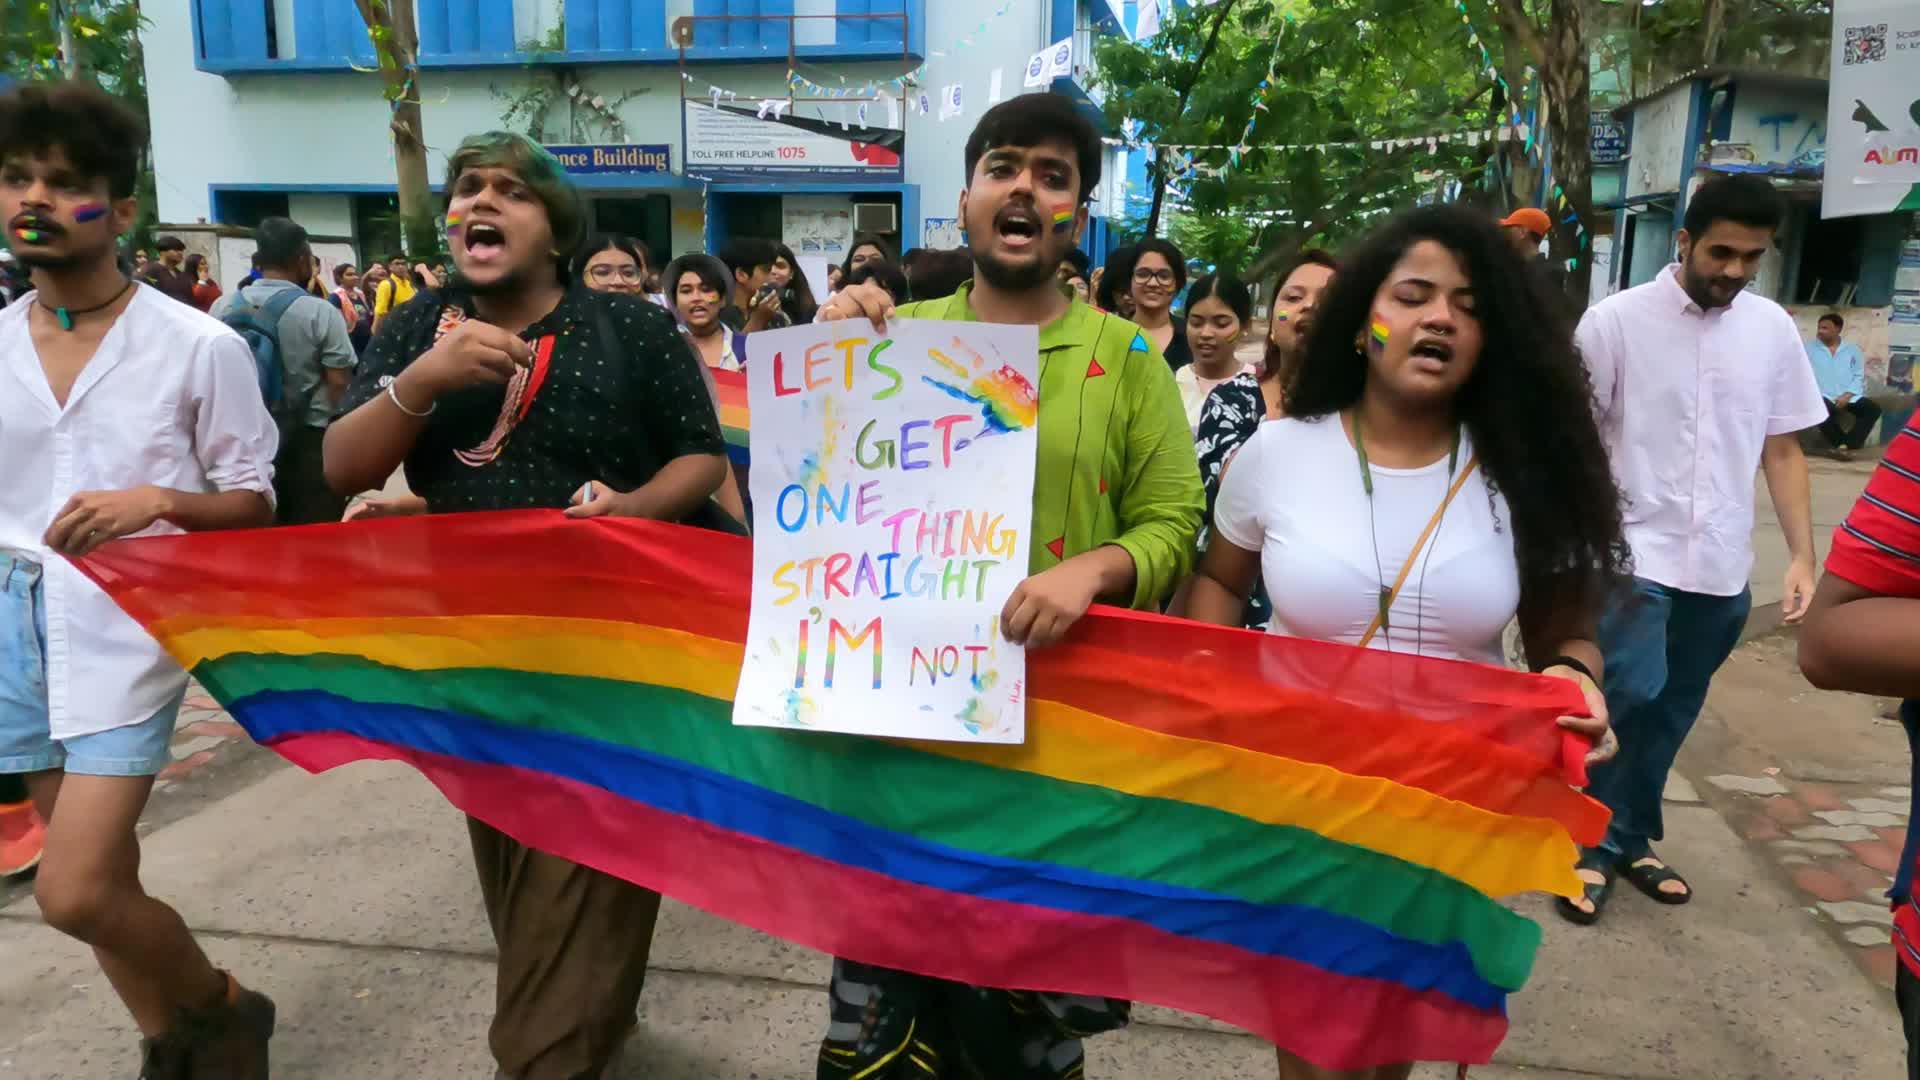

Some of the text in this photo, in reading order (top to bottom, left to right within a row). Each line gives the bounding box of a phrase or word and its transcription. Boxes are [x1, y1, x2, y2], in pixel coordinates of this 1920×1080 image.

[593, 148, 667, 171] Building
[692, 146, 806, 159] TOLL FREE HELPLINE 1075
[773, 338, 905, 401] LETS
[855, 415, 973, 471] GET
[776, 480, 1017, 560] ONE THING
[772, 551, 1001, 607] STRAIGHT
[794, 606, 989, 690] I'M NOT
